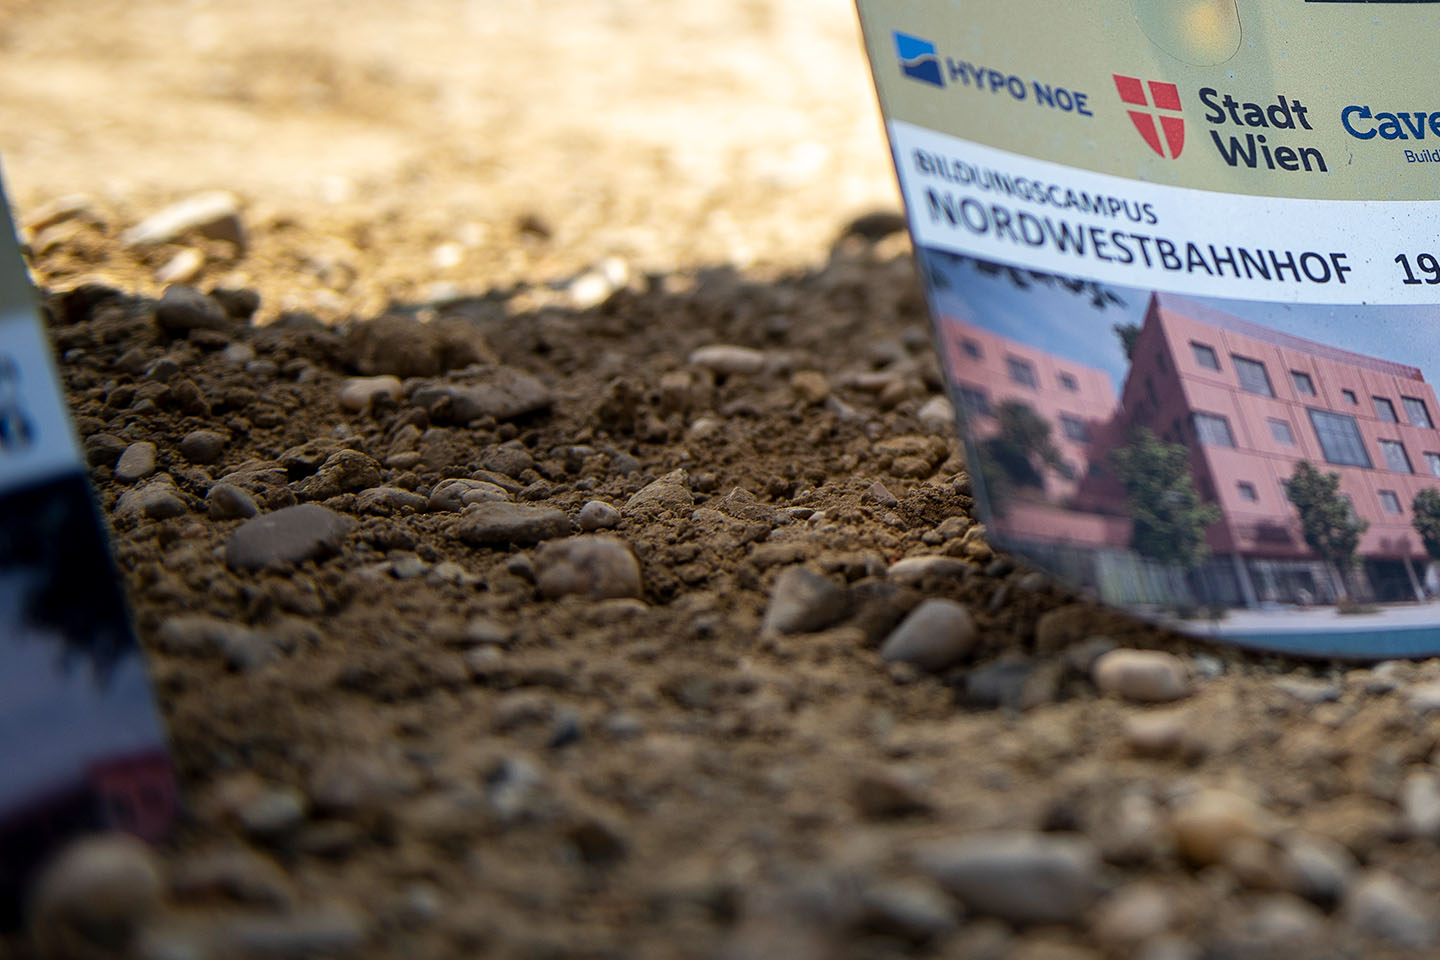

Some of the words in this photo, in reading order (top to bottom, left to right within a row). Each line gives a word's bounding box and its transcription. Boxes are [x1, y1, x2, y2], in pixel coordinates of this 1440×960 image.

[945, 57, 1027, 102] HYPO
[1033, 80, 1093, 118] NOE
[1198, 87, 1313, 131] Stadt
[1209, 130, 1328, 172] Wien
[912, 148, 1159, 226] BILDUNGSCAMPUS
[925, 188, 1352, 285] NORDWESTBAHNHOF
